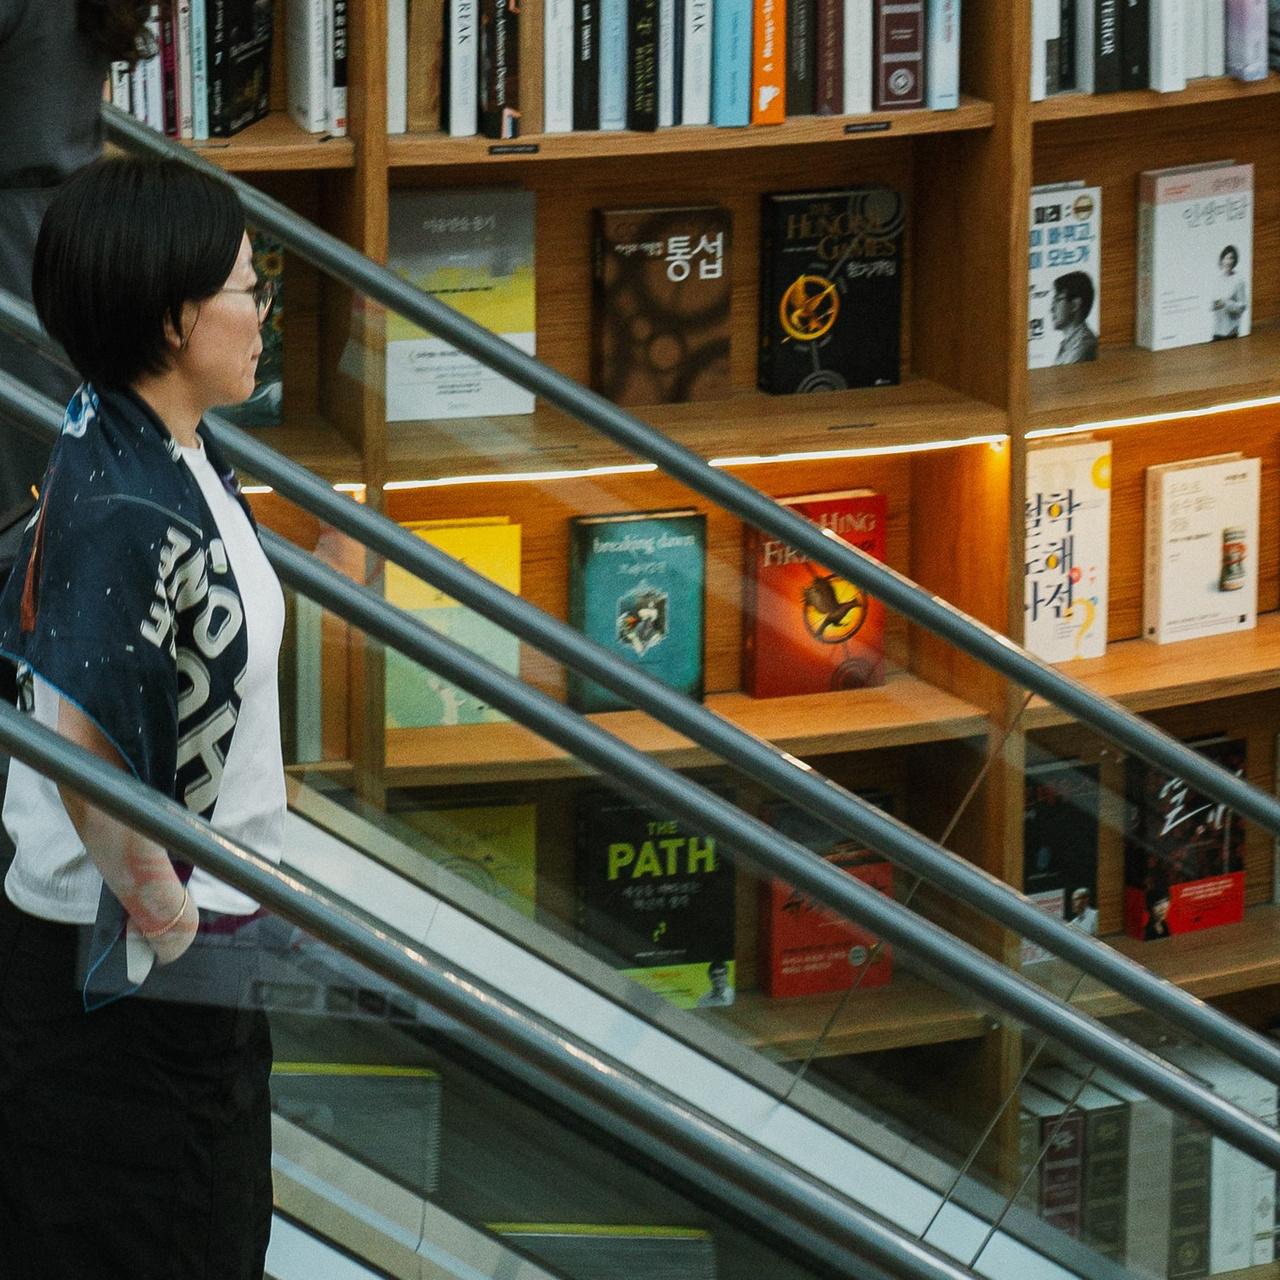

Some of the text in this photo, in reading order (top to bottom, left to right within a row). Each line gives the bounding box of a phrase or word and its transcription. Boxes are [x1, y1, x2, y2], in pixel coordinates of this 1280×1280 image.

[581, 4, 593, 21] and
[763, 64, 774, 72] A
[665, 232, 725, 282] 통섭
[593, 533, 695, 555] breaking dawn
[646, 821, 678, 837] THE
[607, 835, 718, 882] PATH
